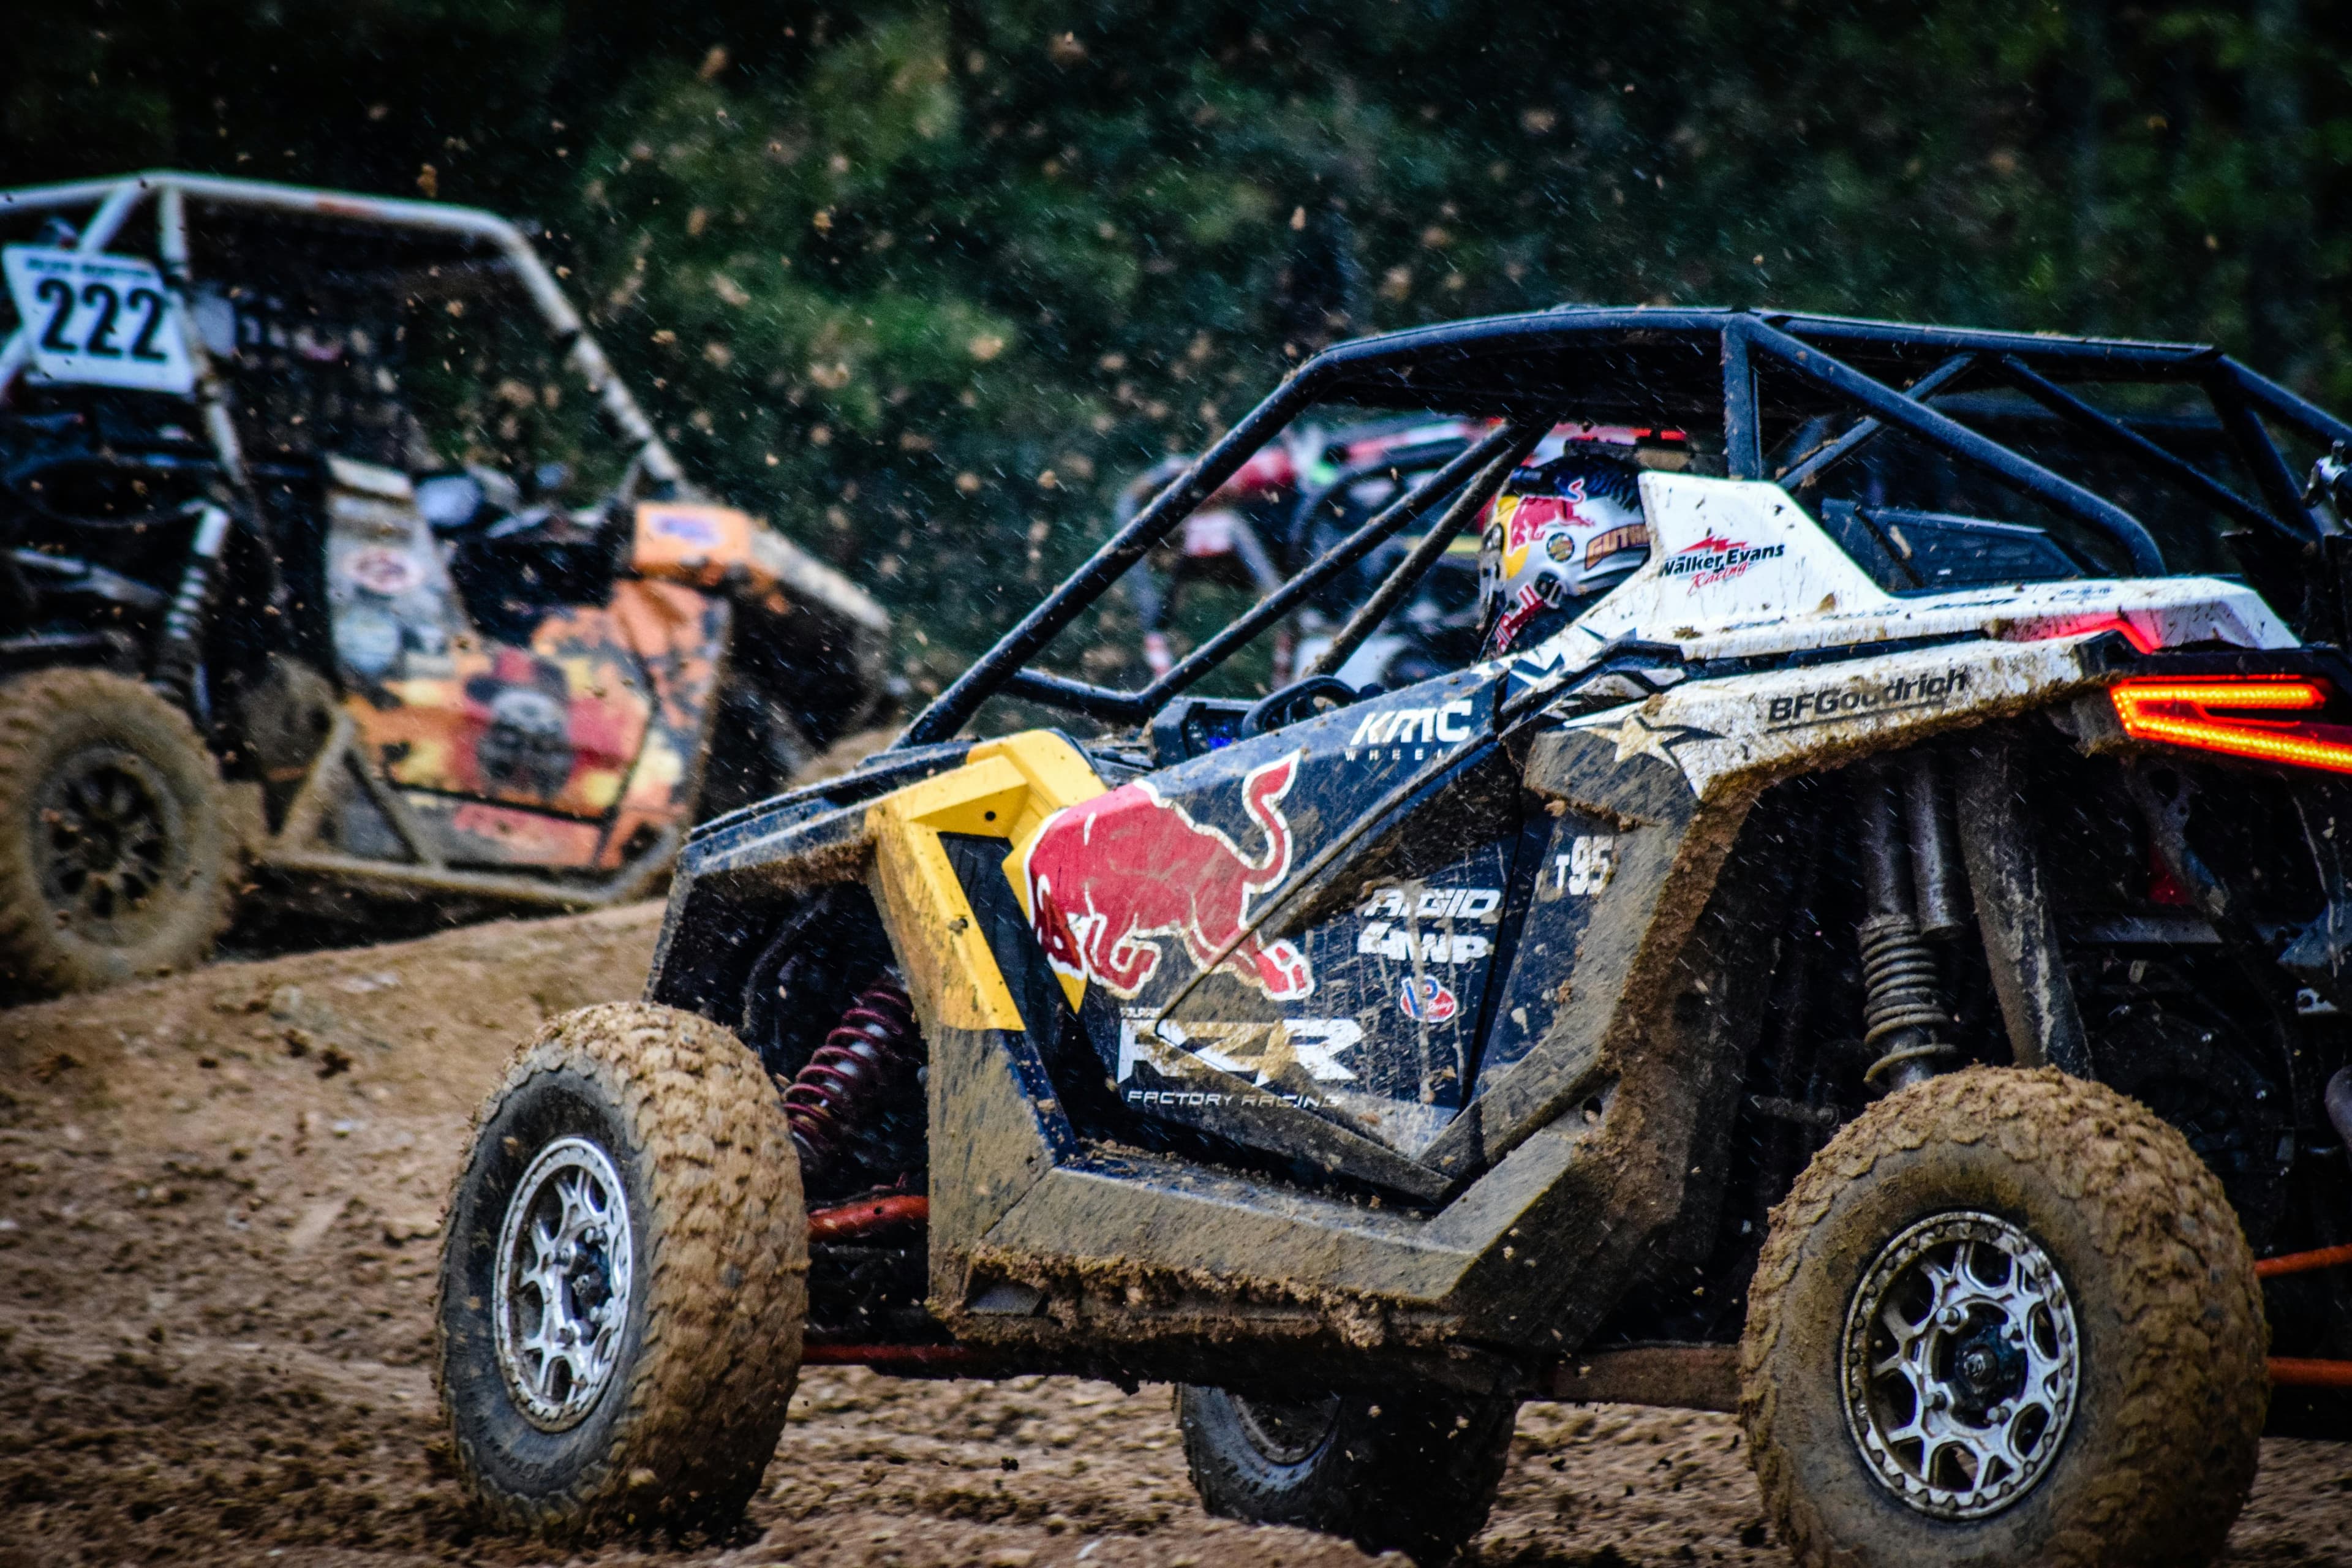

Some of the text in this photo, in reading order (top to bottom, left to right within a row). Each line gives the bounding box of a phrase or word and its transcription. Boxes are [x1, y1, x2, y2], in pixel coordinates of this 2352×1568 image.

[36, 277, 169, 363] 222
[1657, 543, 1785, 578] Walker Evans
[1687, 560, 1749, 598] Racing
[1349, 700, 1472, 745] KMC
[1127, 1090, 1346, 1109] FACTORY RACING
